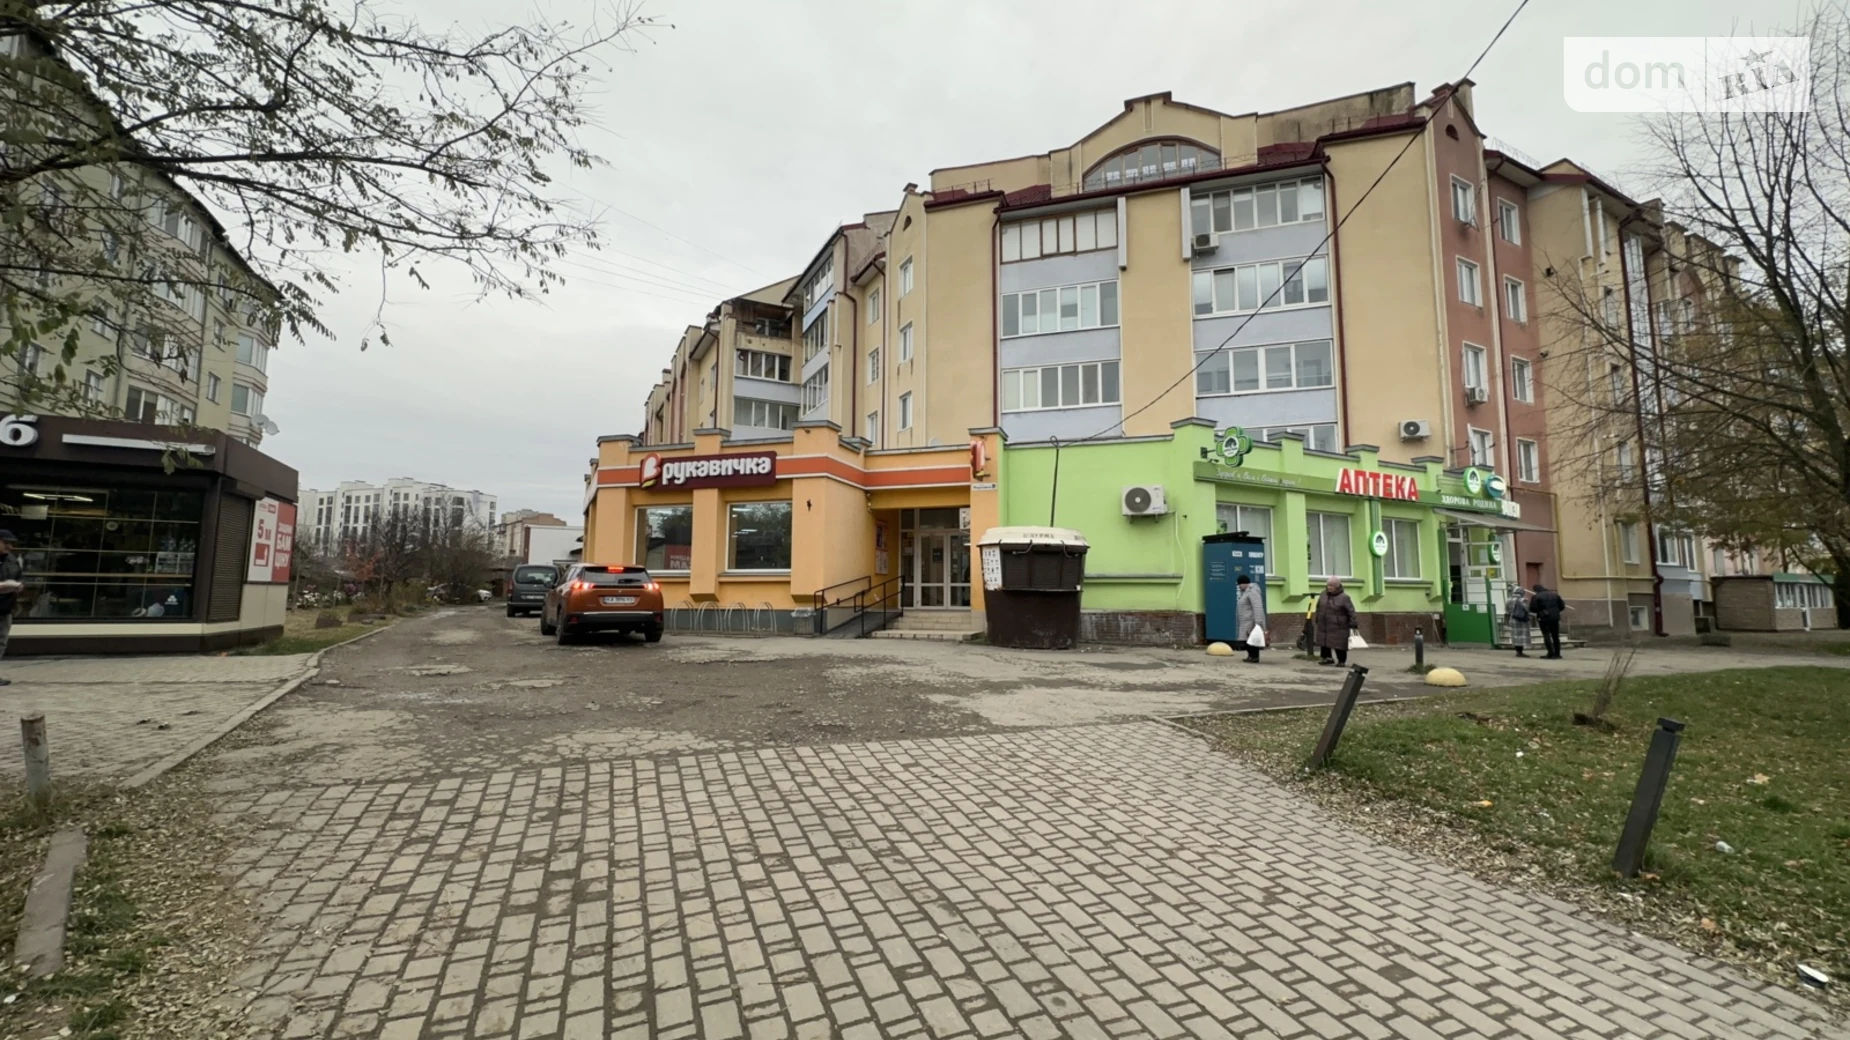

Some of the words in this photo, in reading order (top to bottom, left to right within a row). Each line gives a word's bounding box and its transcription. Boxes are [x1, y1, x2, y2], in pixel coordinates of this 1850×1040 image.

[661, 456, 772, 485] рукавичка
[1335, 468, 1419, 502] АПТЕКА
[1441, 495, 1470, 506] ЗДОРОВА
[257, 519, 264, 539] 5
[670, 559, 691, 570] МА
